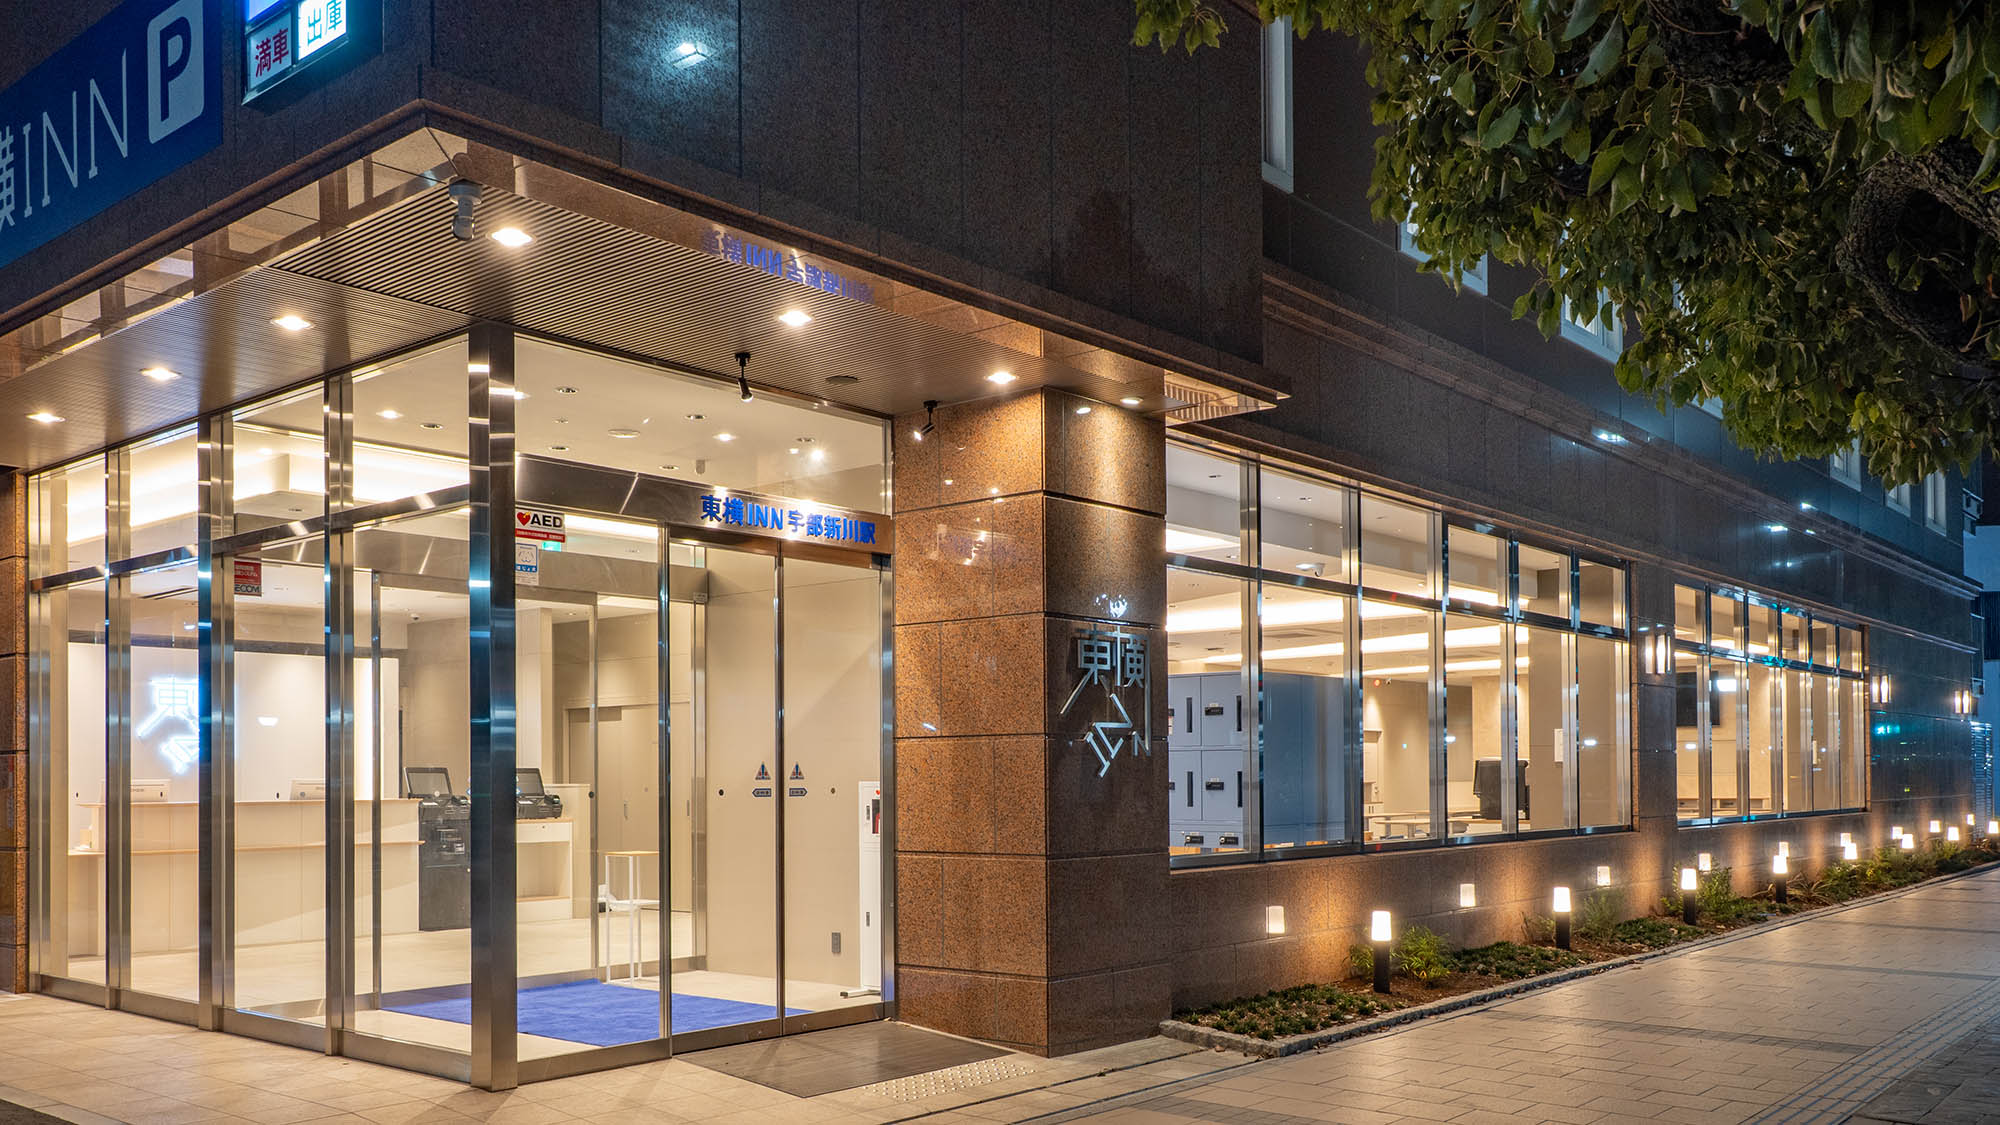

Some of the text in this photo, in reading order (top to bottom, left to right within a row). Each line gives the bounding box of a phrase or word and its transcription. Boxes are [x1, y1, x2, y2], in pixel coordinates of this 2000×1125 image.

[307, 0, 343, 46] 出庫
[159, 16, 192, 123] P
[255, 28, 289, 77] 満車
[530, 513, 562, 528] AED
[700, 495, 876, 545] 東横INN 宇部新川駅
[234, 583, 260, 593] ECOM
